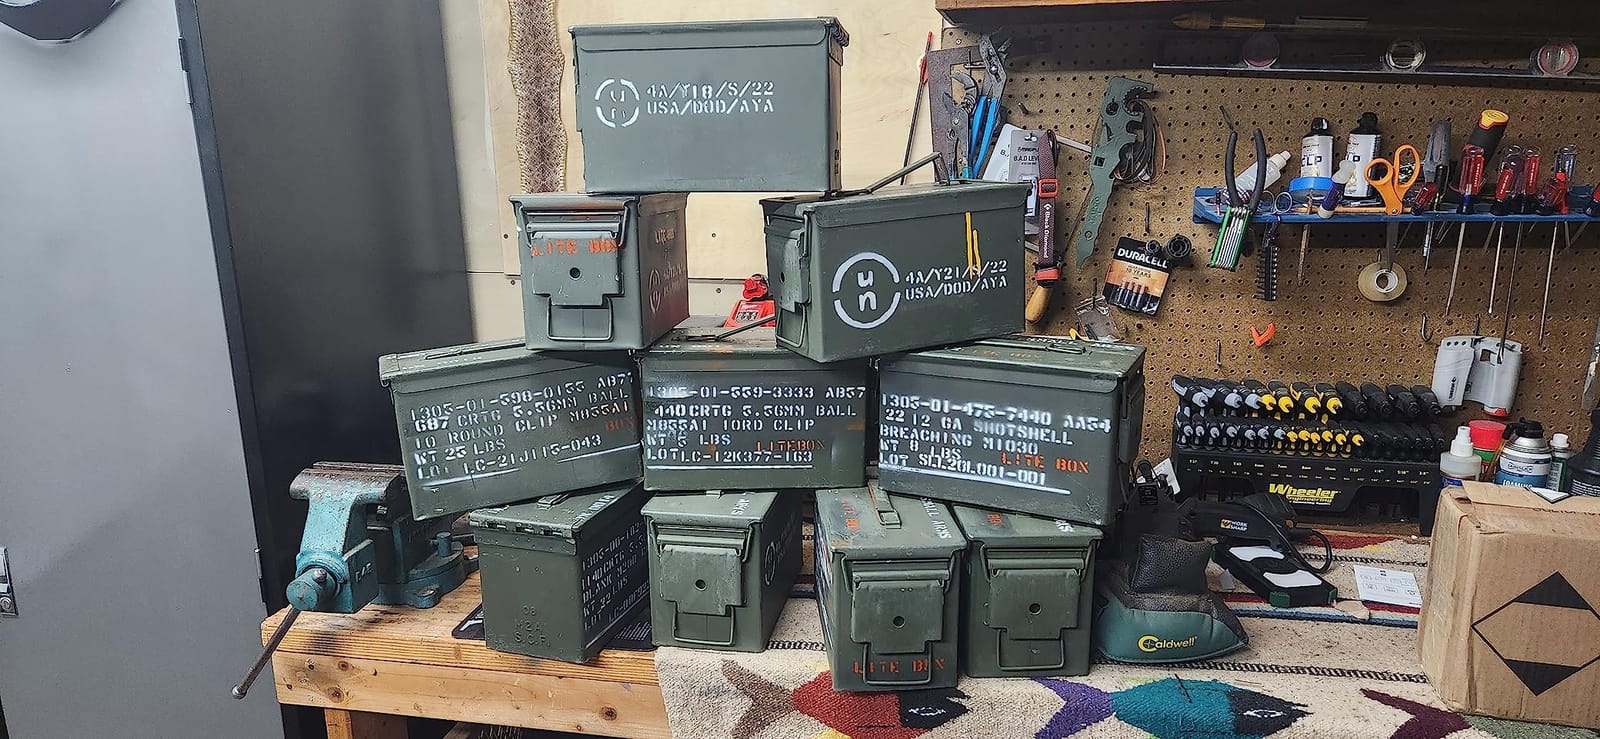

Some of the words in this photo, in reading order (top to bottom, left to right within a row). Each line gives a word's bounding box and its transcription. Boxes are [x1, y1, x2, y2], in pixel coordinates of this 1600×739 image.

[647, 99, 774, 115] USA/DOD/AYA
[1117, 248, 1168, 269] DURACELL
[905, 275, 1007, 301] USA/DOD/AYA
[411, 380, 585, 421] 1305-01-598-0155
[649, 386, 814, 399] 1305-01-559-3333
[825, 386, 867, 399] AB57
[414, 415, 449, 432] 687
[457, 409, 501, 427] CRTG
[512, 396, 577, 418] 5.56MM
[588, 388, 629, 404] BALL
[742, 404, 806, 417] 5.56MM
[815, 404, 857, 417] BALL
[881, 393, 1052, 426] 1305-01-475-7440
[1062, 414, 1112, 434] AA54
[415, 435, 437, 449] 10
[447, 424, 504, 444] ROUND
[514, 413, 558, 432] CLIP
[568, 401, 629, 422] M855A1
[646, 419, 708, 431] M855A1
[773, 419, 815, 431] CLIP
[885, 408, 905, 423] 22
[911, 413, 932, 428] 12
[940, 416, 963, 431] GA
[973, 420, 1074, 446] SHOTSHELL
[699, 434, 732, 446] LBS
[880, 423, 973, 448] BREACHING
[473, 438, 507, 456] LBS
[930, 446, 962, 461] LBS
[880, 452, 909, 467] LOT
[1001, 452, 1046, 469] LITE
[1055, 458, 1090, 474] BOX
[1269, 483, 1339, 497] Wheeler
[1138, 635, 1196, 652] Caldwell
